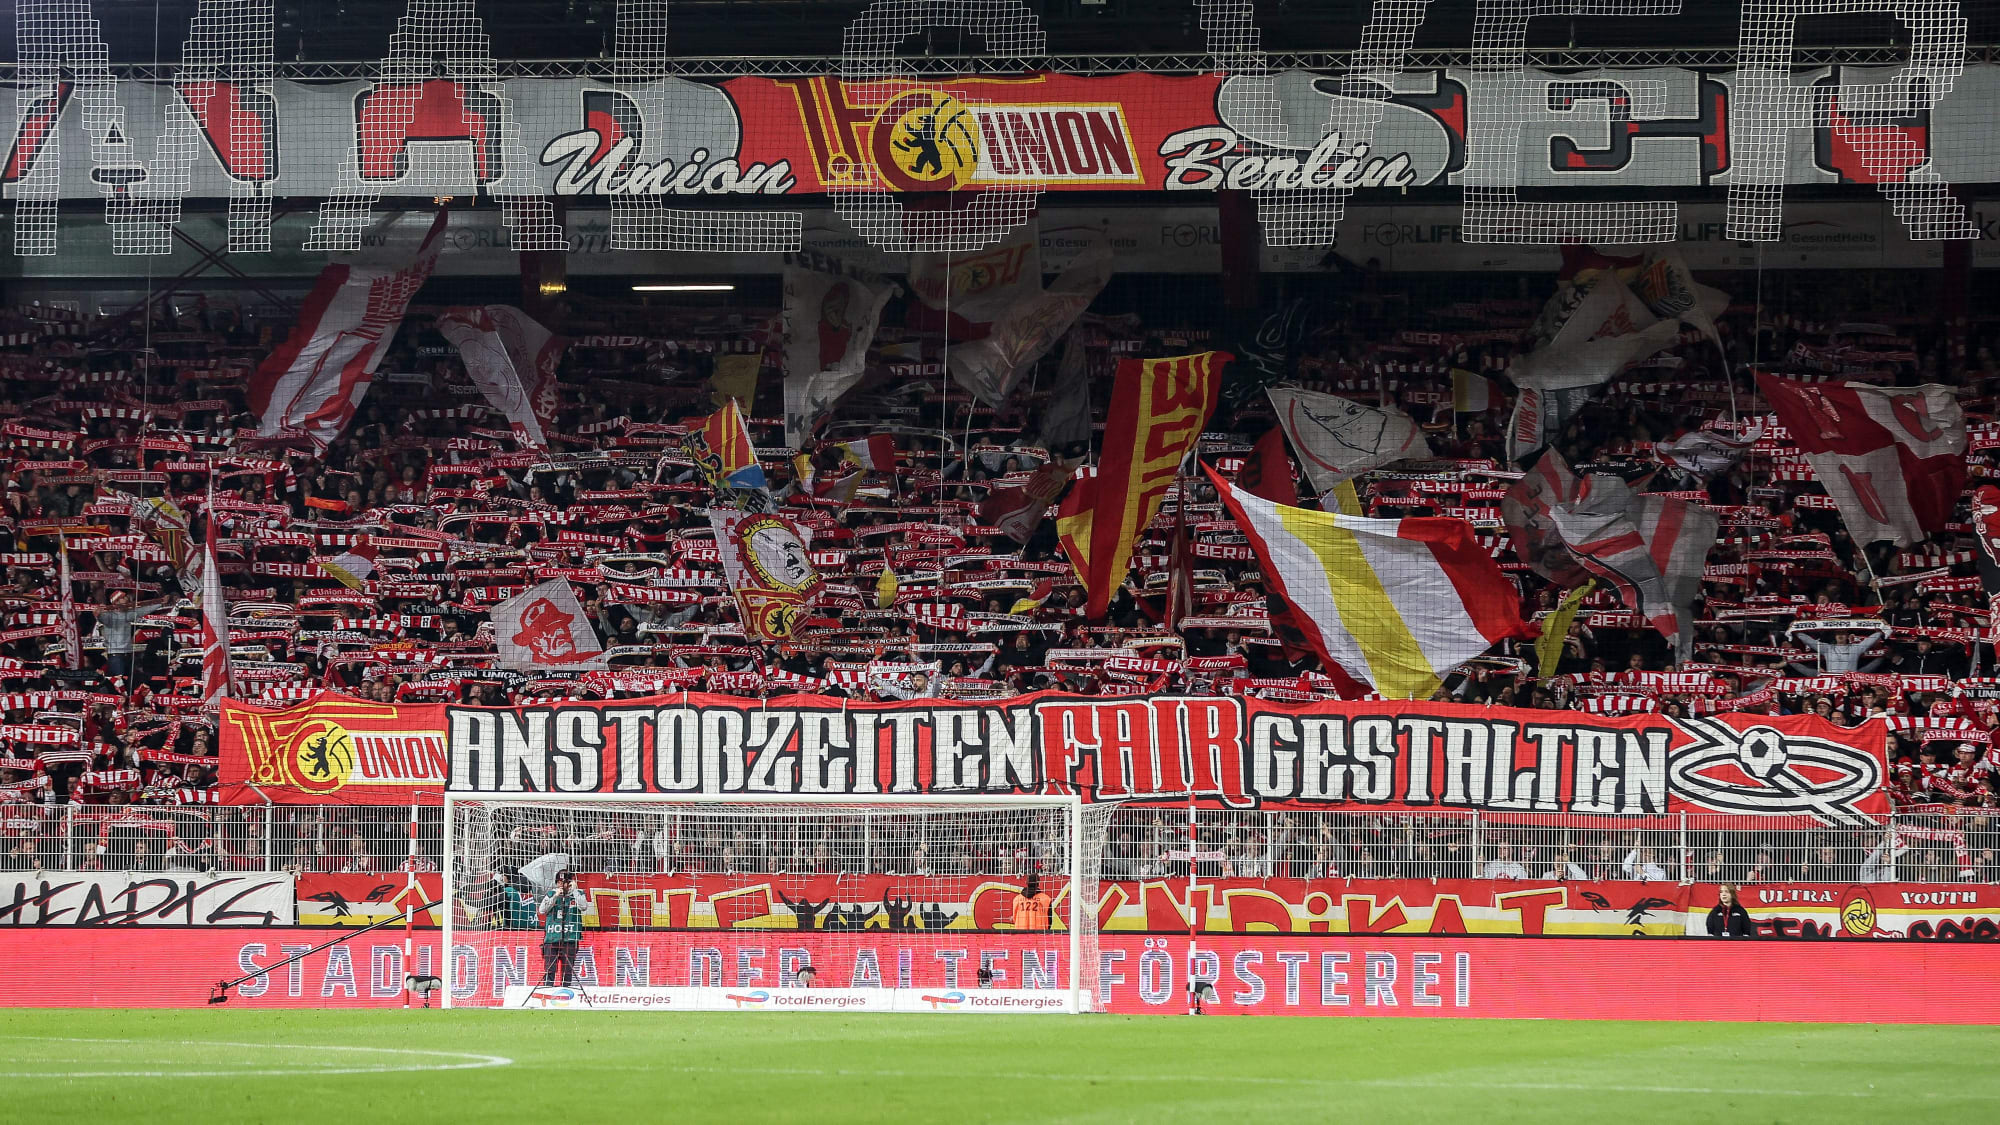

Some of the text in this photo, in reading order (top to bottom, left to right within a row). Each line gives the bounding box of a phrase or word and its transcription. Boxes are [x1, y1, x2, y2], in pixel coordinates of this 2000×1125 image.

[986, 110, 1136, 176] UNION
[541, 130, 795, 195] Union
[1158, 127, 1416, 191] Berlin
[26, 426, 49, 437] Union
[166, 462, 207, 471] UNIONER
[1382, 497, 1426, 506] UNIONER
[90, 505, 126, 515] UNION
[106, 543, 135, 552] Union
[372, 539, 441, 550] BLUTEN FÜR UNION
[679, 539, 713, 549] UNION
[491, 568, 520, 576] UNION
[546, 568, 577, 577] Union
[1001, 561, 1011, 569] FC
[1014, 562, 1042, 571] Union
[1044, 562, 1070, 573] Berlin
[318, 589, 343, 597] Union
[424, 605, 450, 615] Union
[1199, 659, 1230, 668] Union
[430, 670, 477, 682] EISERN
[408, 681, 448, 691] UNIONER
[1252, 679, 1298, 688] UNIONER
[159, 752, 171, 761] FC
[173, 755, 201, 764] Union
[358, 734, 448, 782] UNION
[1038, 697, 1257, 808] FAIR
[1253, 713, 1668, 814] GESTALTEN
[1900, 891, 1977, 904] YOUTH
[1020, 901, 1038, 912] 122
[547, 924, 575, 933] HOST
[238, 943, 528, 998] STADION
[571, 945, 651, 988] AN
[1100, 938, 1471, 1007] FÖRSTEREI
[577, 993, 671, 1006] TotalEnergies
[772, 995, 866, 1007] TotalEnergies
[968, 996, 1063, 1008] TotalEnergies
